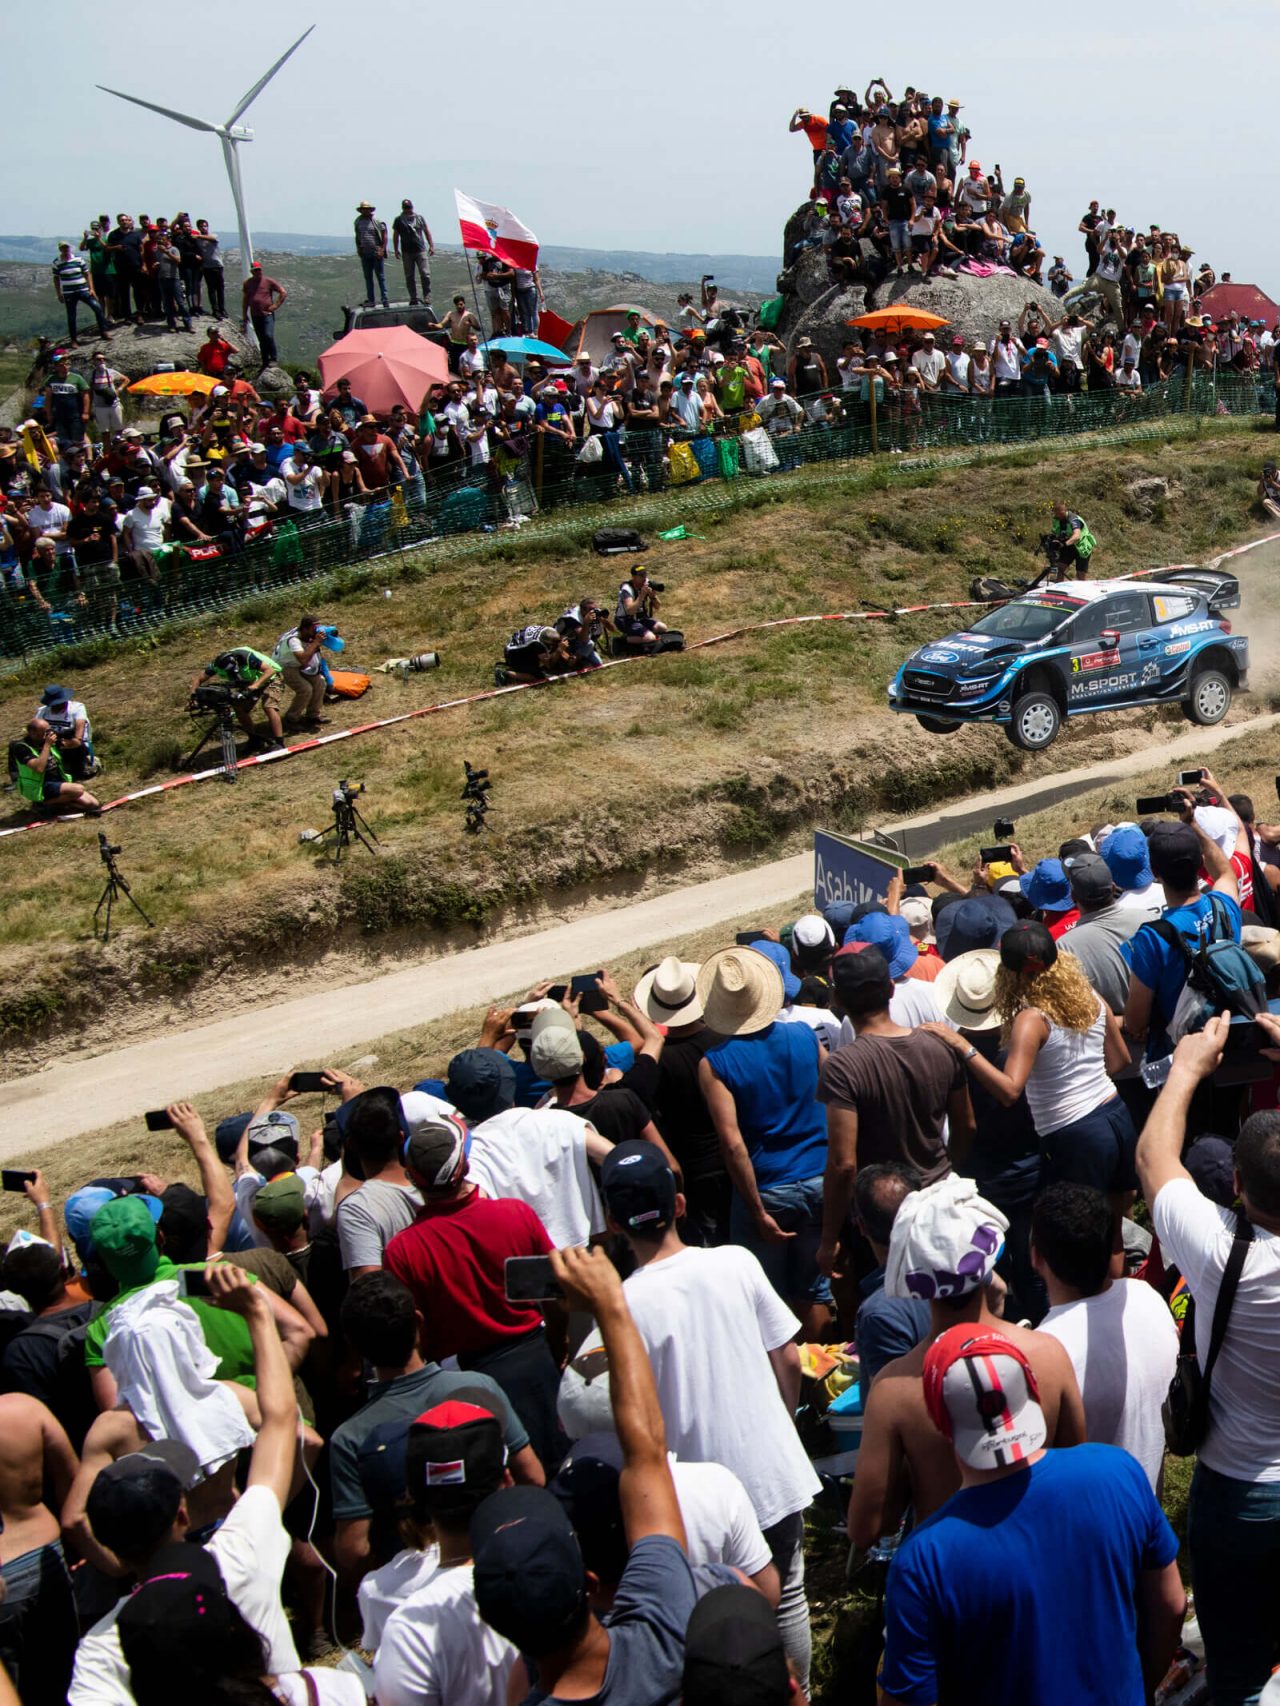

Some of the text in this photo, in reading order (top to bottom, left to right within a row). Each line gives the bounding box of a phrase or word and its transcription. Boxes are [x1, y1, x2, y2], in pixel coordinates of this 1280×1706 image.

[1154, 595, 1167, 618] 3
[923, 652, 957, 662] Ford
[1071, 658, 1080, 672] 3
[1071, 672, 1137, 694] M-SPORT
